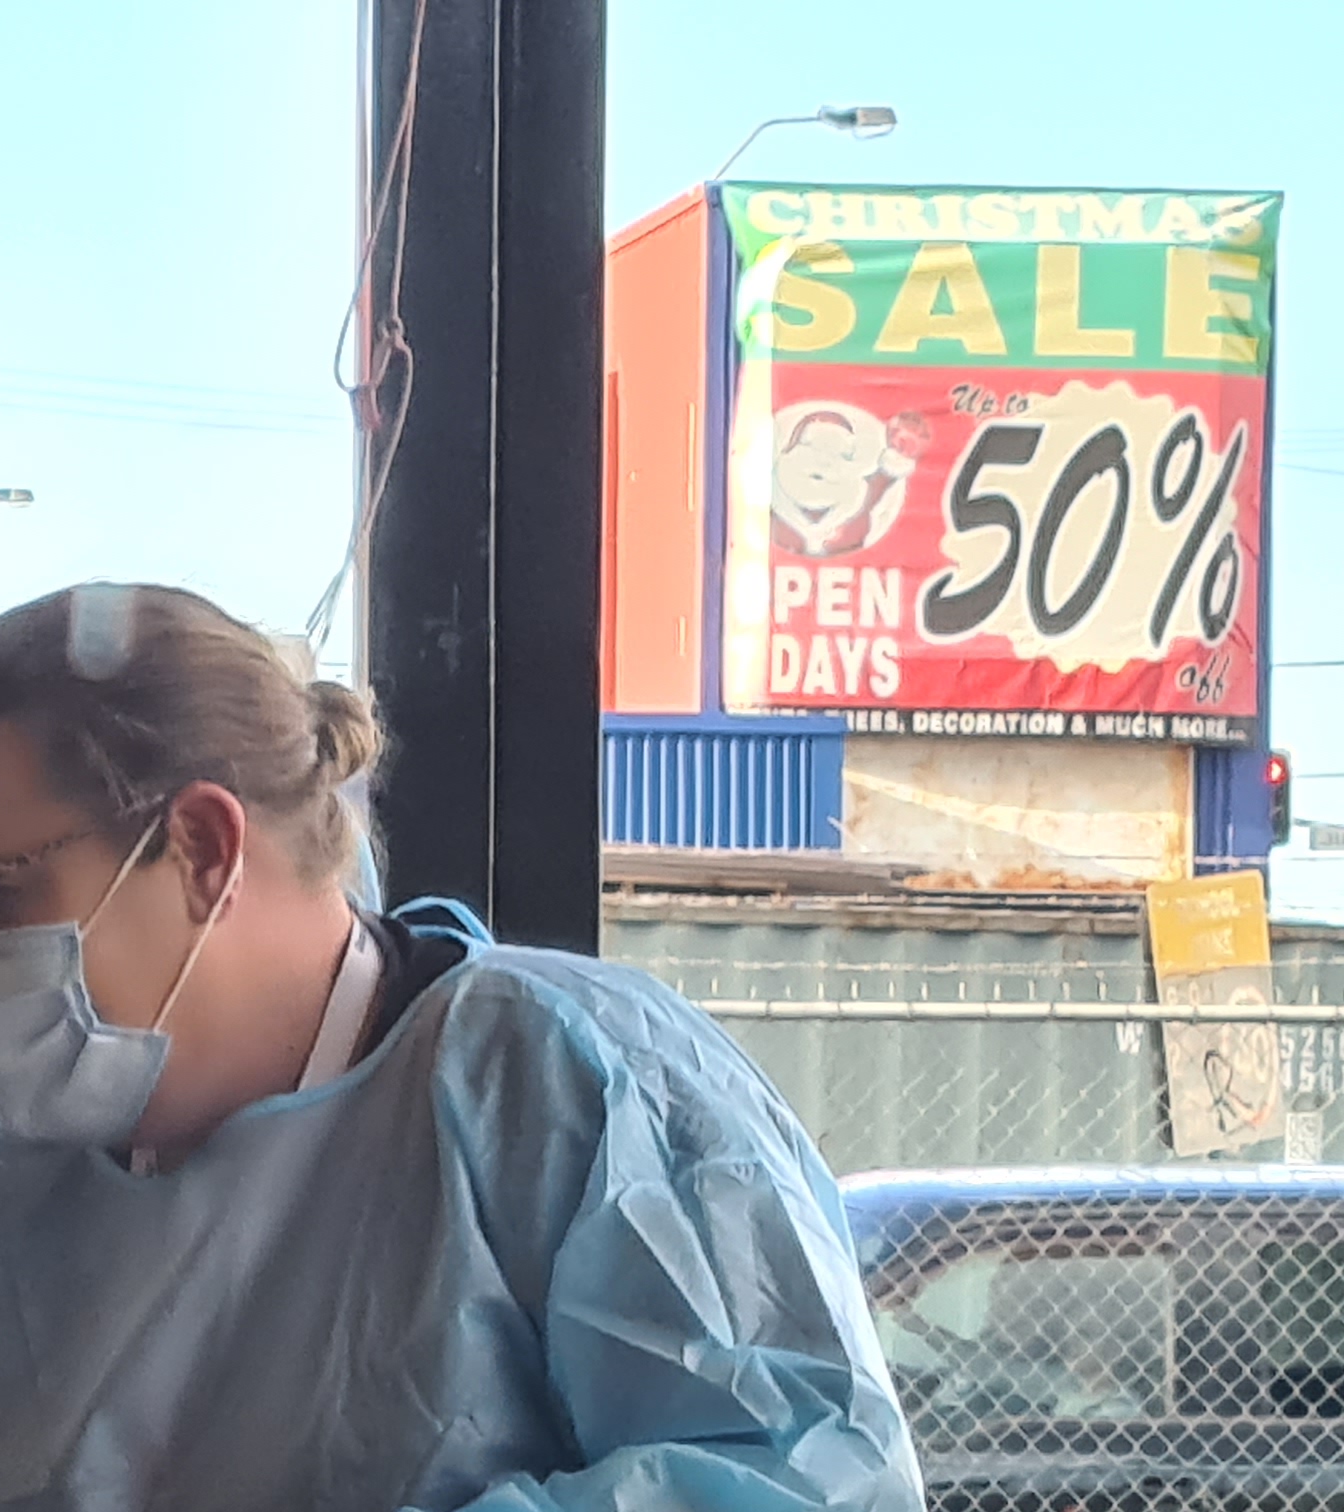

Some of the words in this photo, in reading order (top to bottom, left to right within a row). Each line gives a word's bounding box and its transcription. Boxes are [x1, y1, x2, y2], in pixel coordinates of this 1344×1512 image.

[752, 239, 1260, 363] SALE
[951, 384, 994, 417] Up
[1004, 393, 1030, 414] to
[922, 413, 1240, 648] 50%
[770, 634, 900, 698] DAYS
[1179, 655, 1229, 703] off
[913, 711, 1064, 738] DECORATION
[1070, 714, 1087, 736] &
[1095, 714, 1165, 739] MUCH
